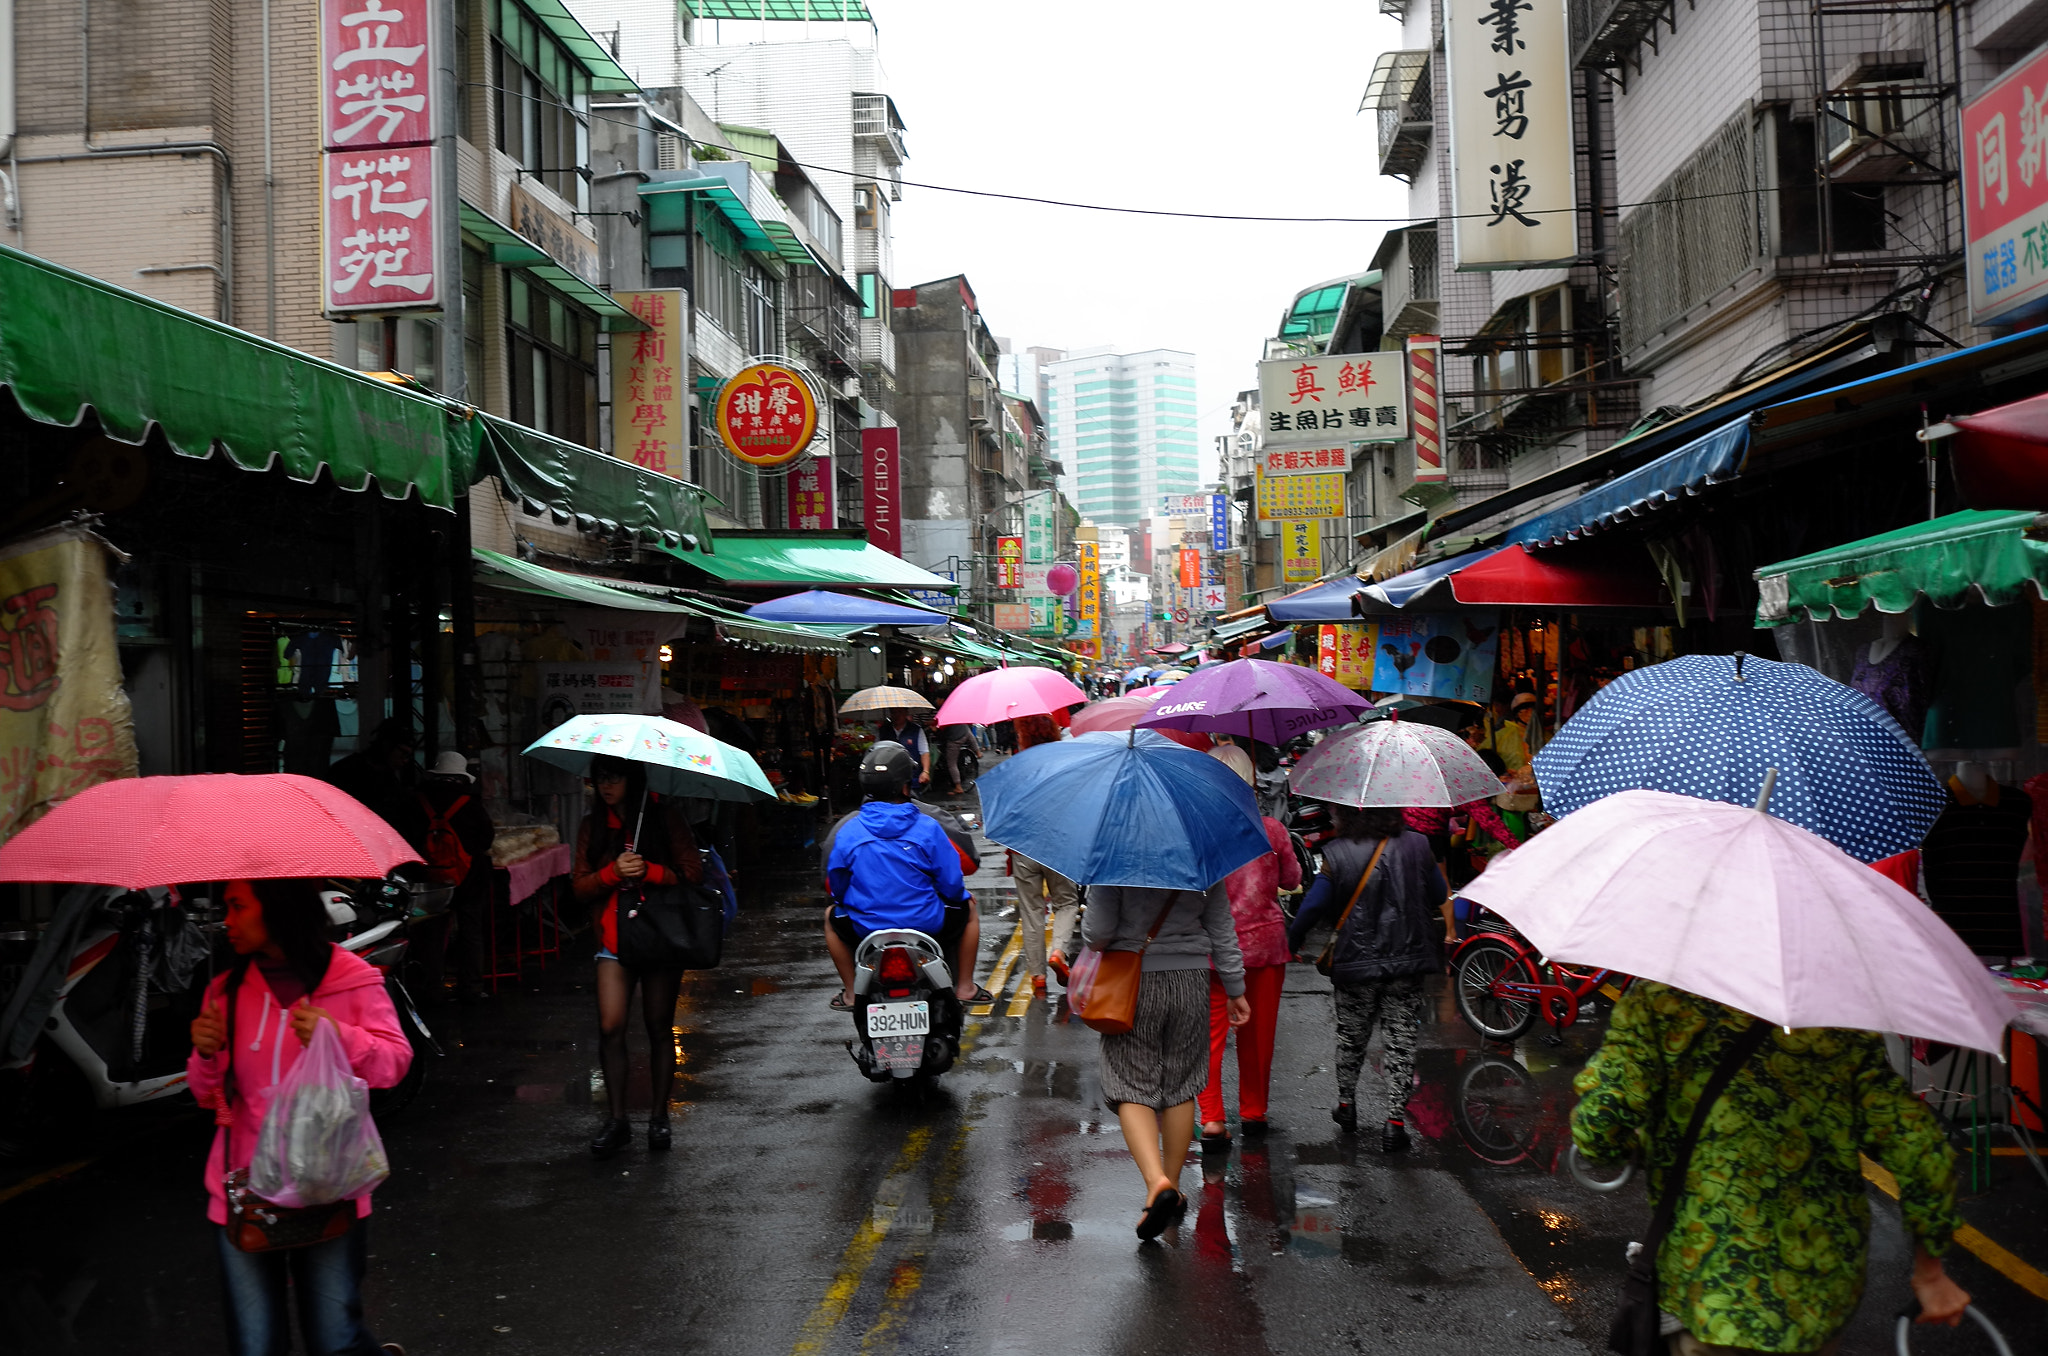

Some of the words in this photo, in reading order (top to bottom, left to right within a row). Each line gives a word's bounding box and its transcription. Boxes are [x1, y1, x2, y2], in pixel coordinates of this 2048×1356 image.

[1983, 238, 2018, 296] 磁器
[1288, 360, 1377, 405] 真鮮
[733, 385, 798, 415] 甜馨
[1269, 405, 1397, 432] 生魚片專賣
[1268, 448, 1346, 471] 炸蝦天婦羅
[873, 447, 891, 541] SHISEIDO
[1156, 701, 1208, 716] CLAIRE
[870, 1012, 927, 1032] 392-HUN
